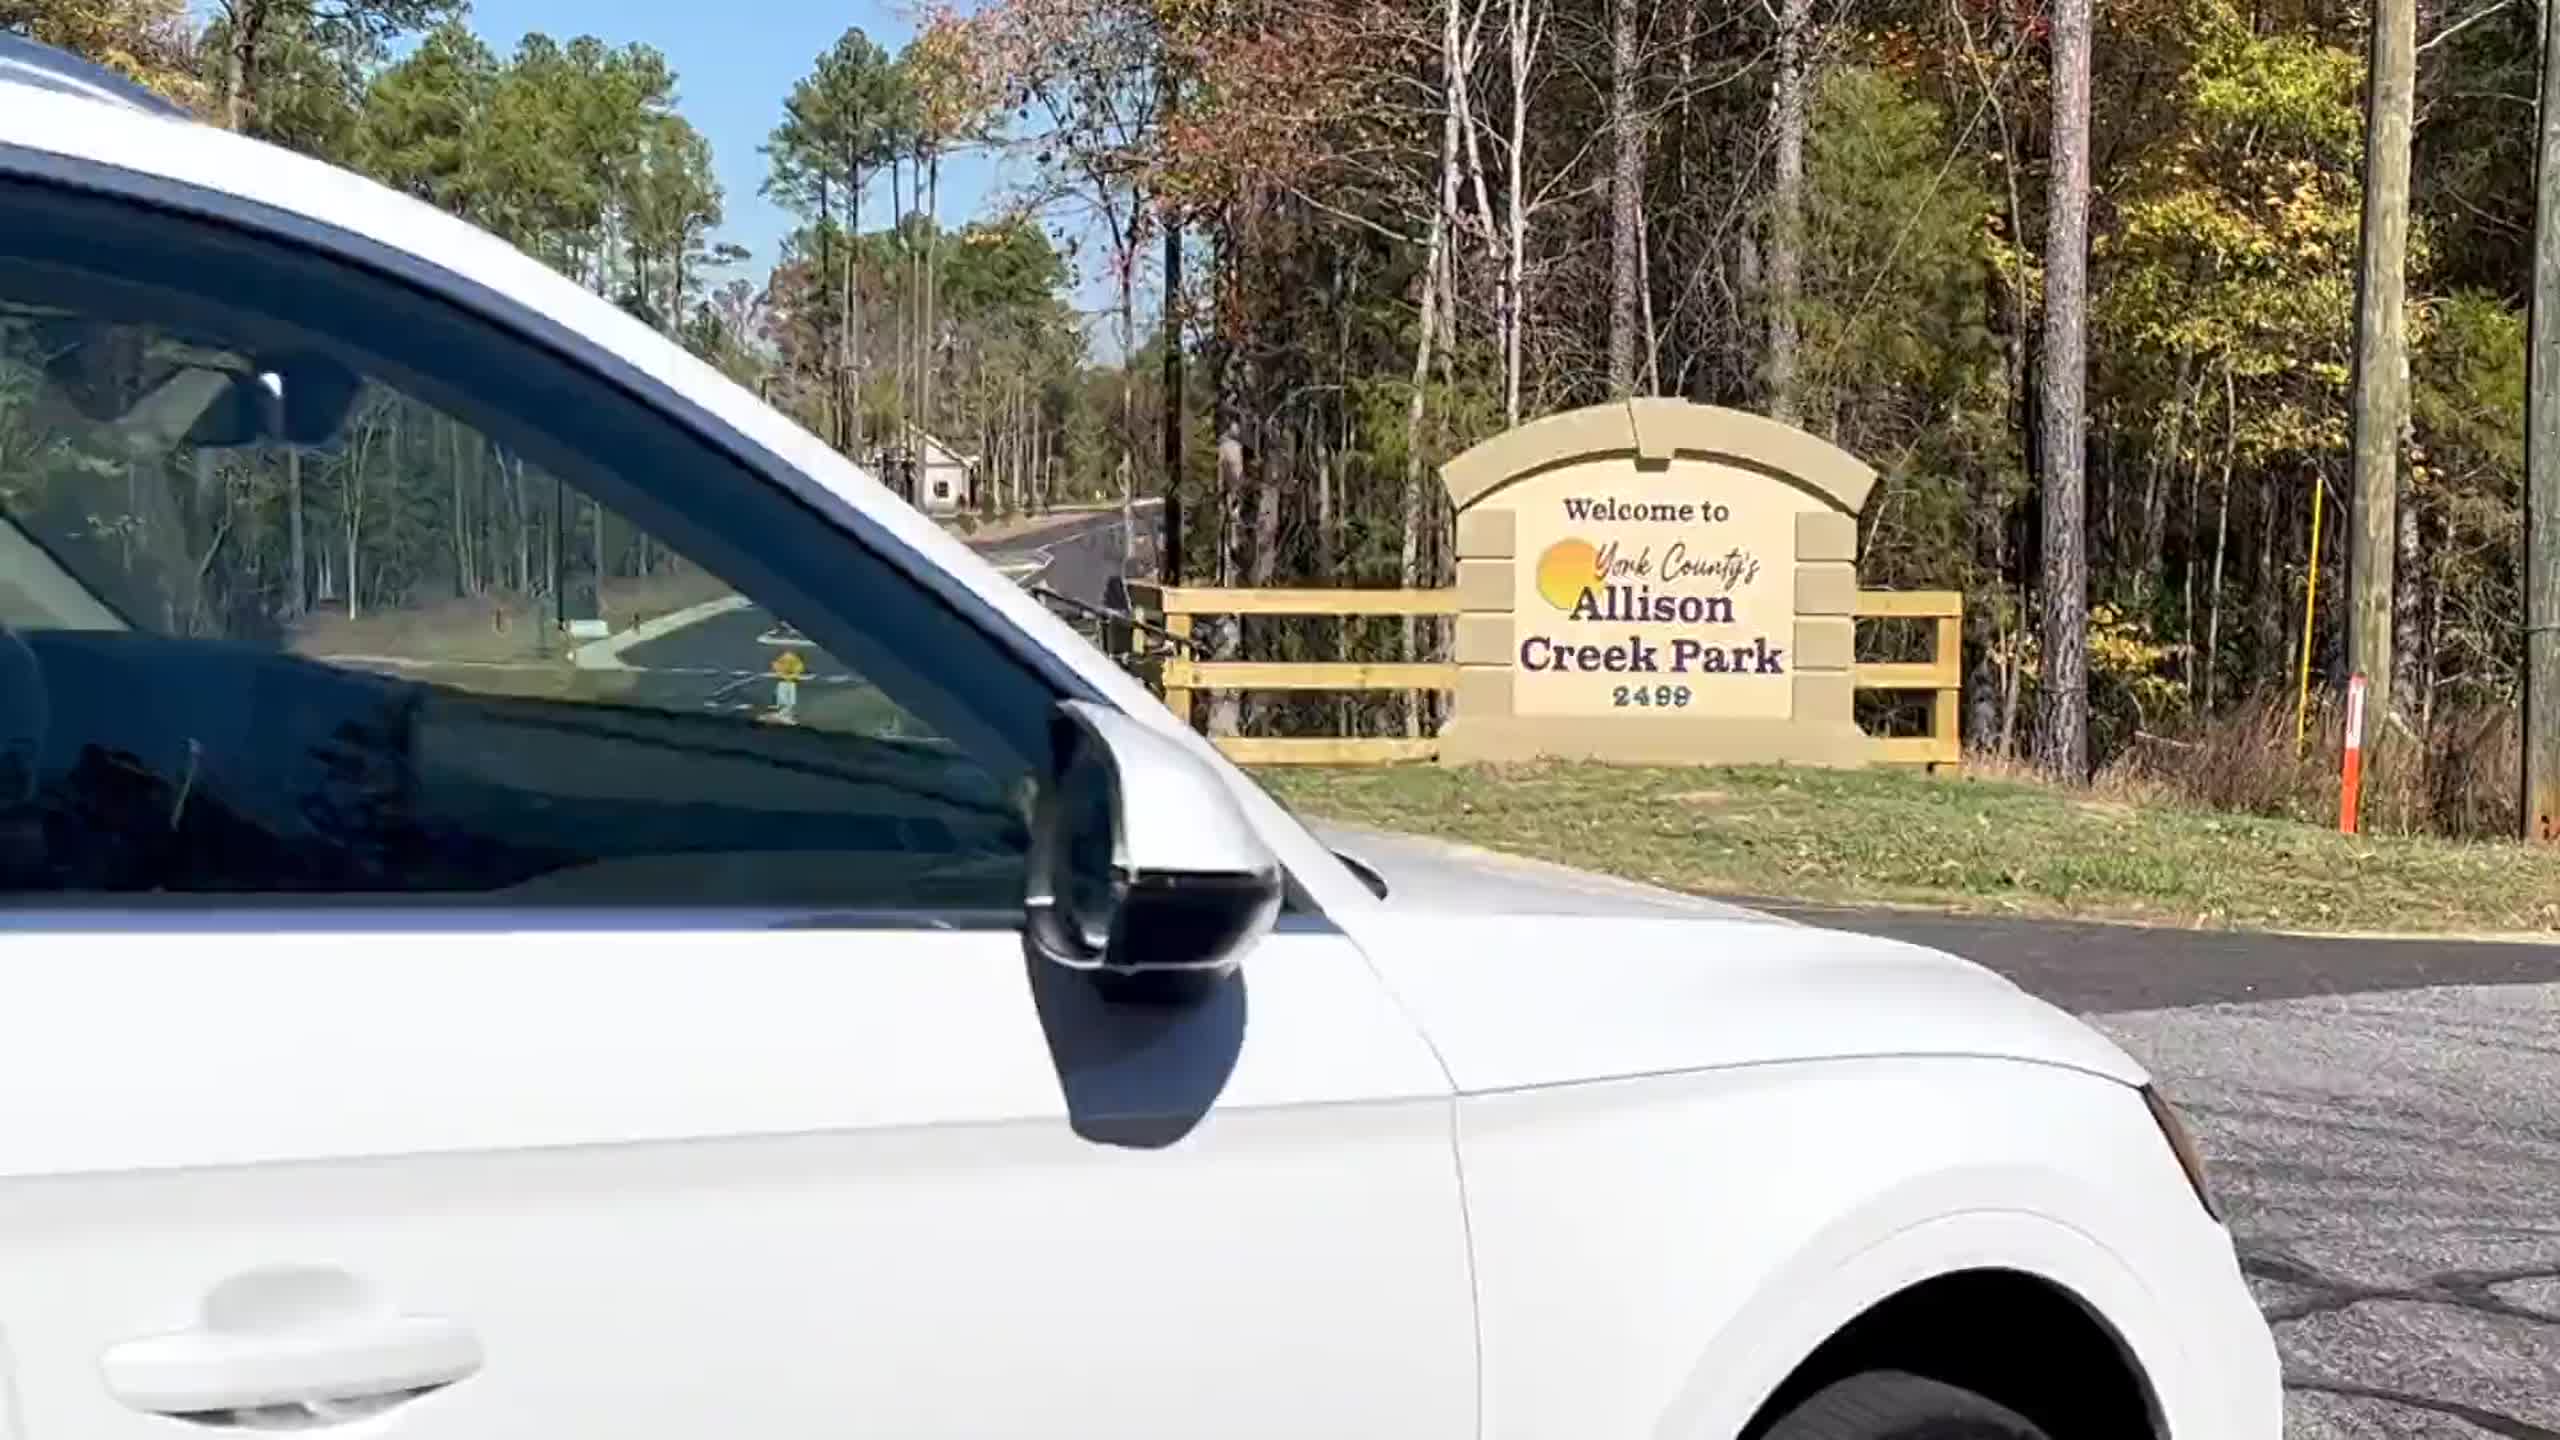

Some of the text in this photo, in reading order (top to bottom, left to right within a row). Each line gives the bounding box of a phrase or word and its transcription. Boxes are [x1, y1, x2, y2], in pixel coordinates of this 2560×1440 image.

[1563, 498, 1730, 523] Welcome to
[1594, 541, 1761, 590] York County's
[1568, 585, 1734, 623] Allison
[1520, 636, 1785, 674] Creek Park
